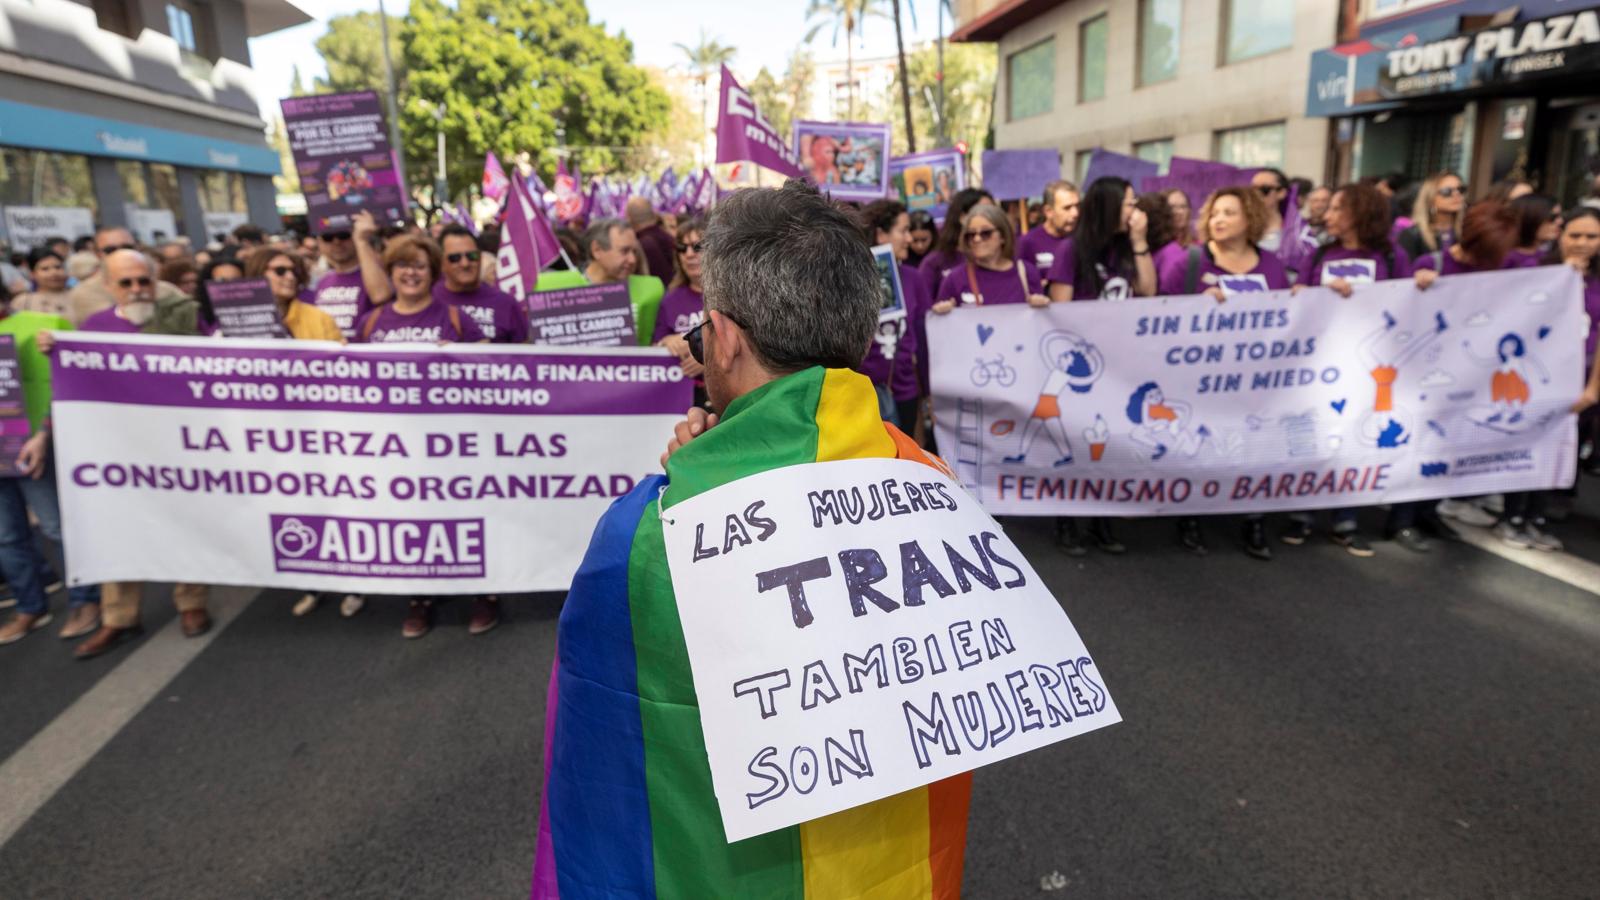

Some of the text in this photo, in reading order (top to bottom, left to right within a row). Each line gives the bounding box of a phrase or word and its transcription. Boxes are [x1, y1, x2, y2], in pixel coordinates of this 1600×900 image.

[1388, 10, 1600, 78] TONY PLAZA
[540, 323, 565, 337] POR
[565, 322, 579, 335] EL
[580, 315, 625, 333] CAMBIO
[1136, 308, 1290, 337] SIN LÍMITES
[59, 350, 684, 382] POR LA TRANSFORMACIÓN DEL SISTEMA FINANCIERO
[1165, 337, 1317, 365] CON TODAS
[188, 381, 550, 406] Y OTRO MODELO DE CONSUMO
[1197, 366, 1340, 393] SIN MIEDO
[180, 425, 568, 458] LA FUERZA DE LAS
[71, 463, 636, 501] CONSUMIDORAS ORGANIZAD
[998, 464, 1392, 504] FEMINISMO o BARBARIE
[692, 478, 957, 563] LAS MUJERES
[318, 519, 482, 564] ADICAE
[756, 530, 1027, 629] TRANS
[733, 617, 1016, 720] TAMBIEN
[746, 656, 1107, 809] SON MUJERES
